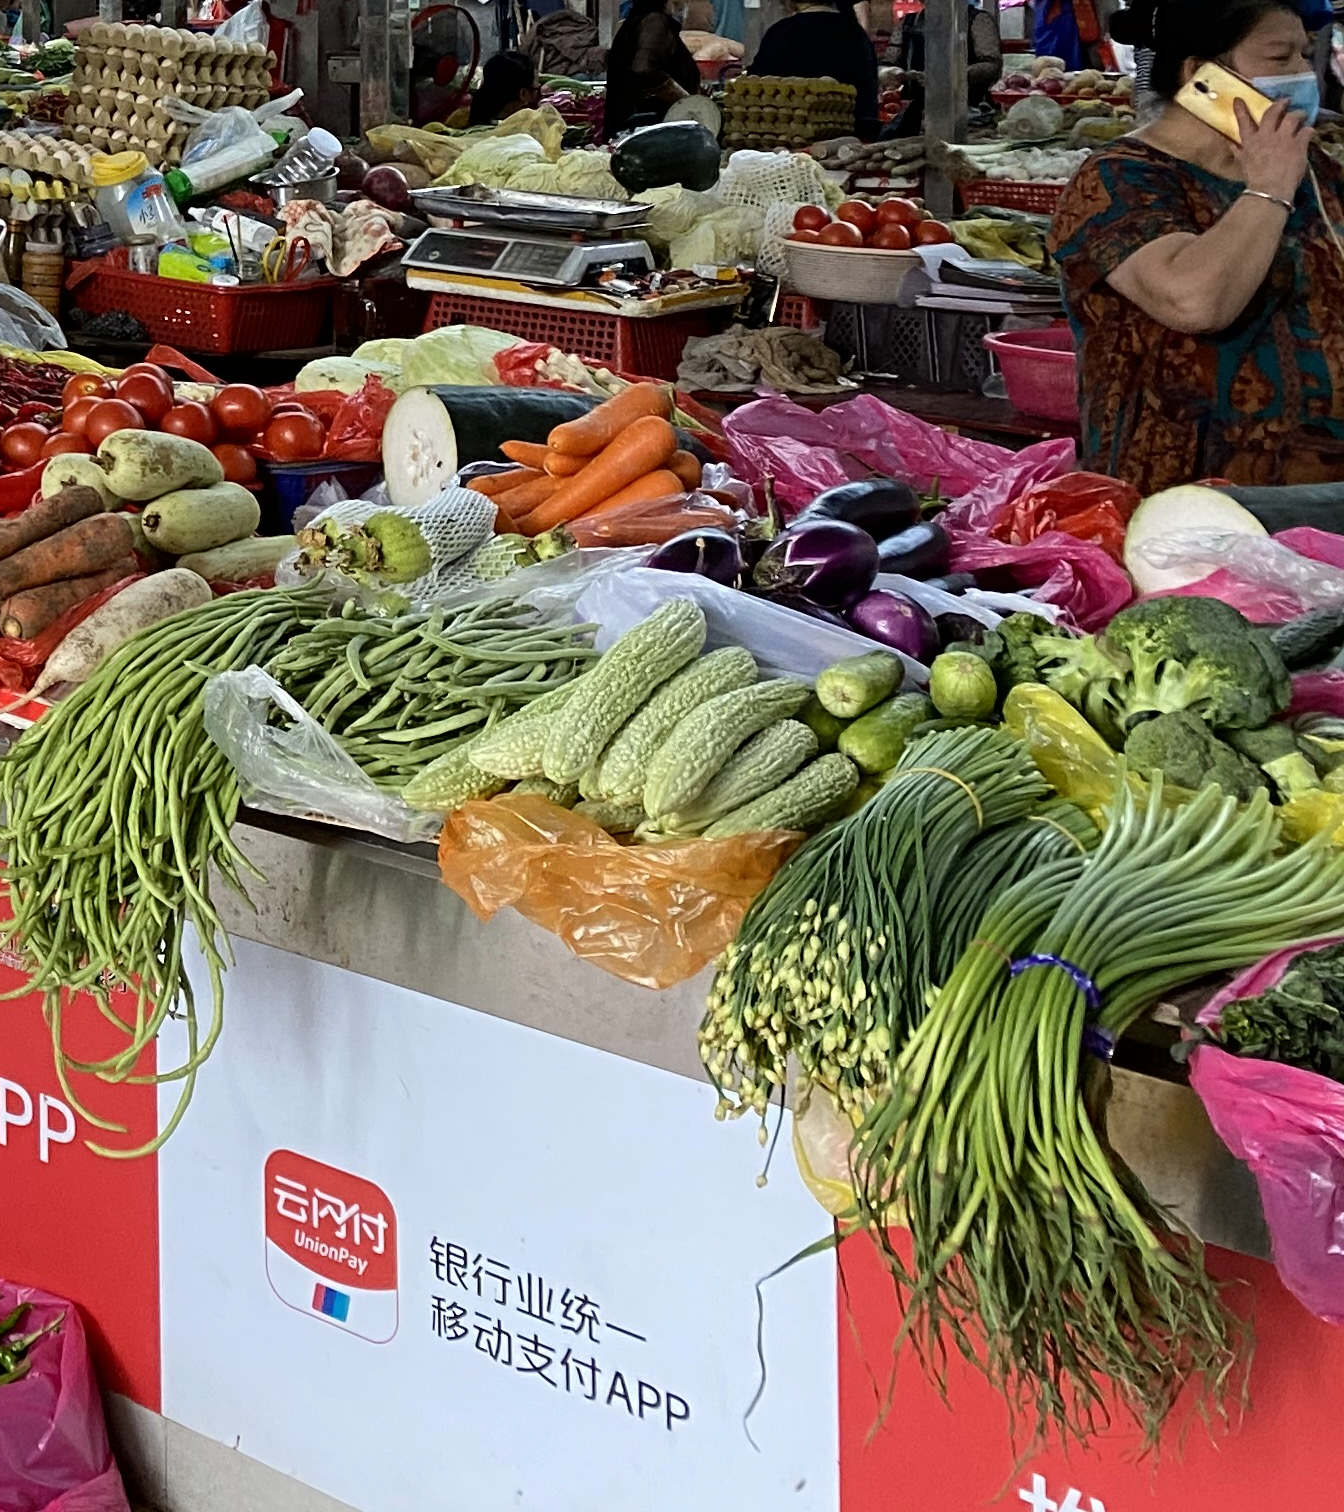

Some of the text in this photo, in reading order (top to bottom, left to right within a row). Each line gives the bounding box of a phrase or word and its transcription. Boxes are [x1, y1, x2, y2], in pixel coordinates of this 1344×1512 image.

[272, 1174, 388, 1255] 云闪付
[293, 1227, 369, 1276] UnionPay
[429, 1235, 647, 1344] 银行业统一
[430, 1293, 691, 1431] 移动支付APP
